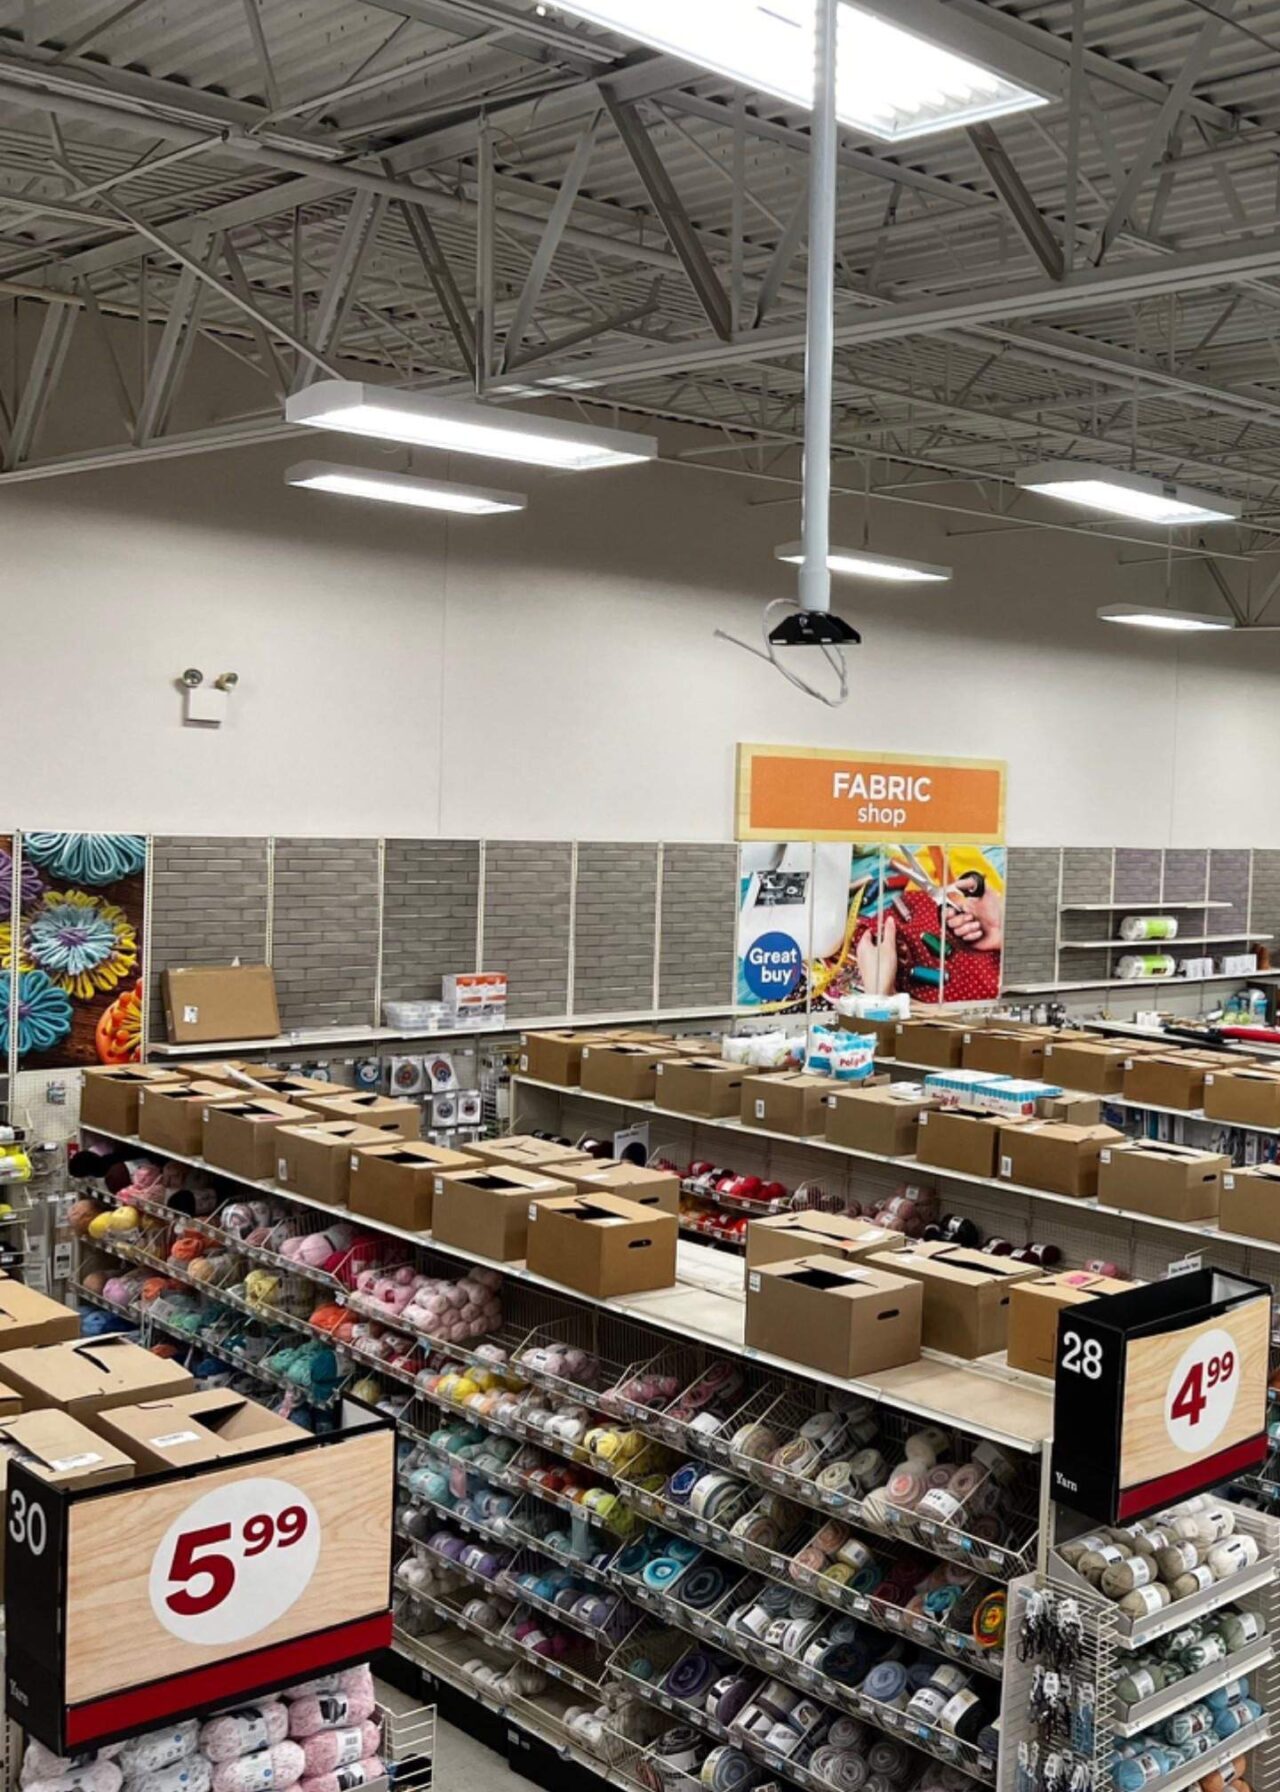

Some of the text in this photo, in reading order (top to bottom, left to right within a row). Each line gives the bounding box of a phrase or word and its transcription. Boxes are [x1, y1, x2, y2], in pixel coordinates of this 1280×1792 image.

[832, 772, 932, 802] FABRIC
[857, 803, 907, 827] shop
[749, 948, 797, 965] Great
[761, 967, 793, 986] buy
[1061, 1331, 1103, 1381] 28
[1056, 1470, 1079, 1493] Yarn
[8, 1489, 48, 1556] 30
[8, 1678, 30, 1707] Yarn
